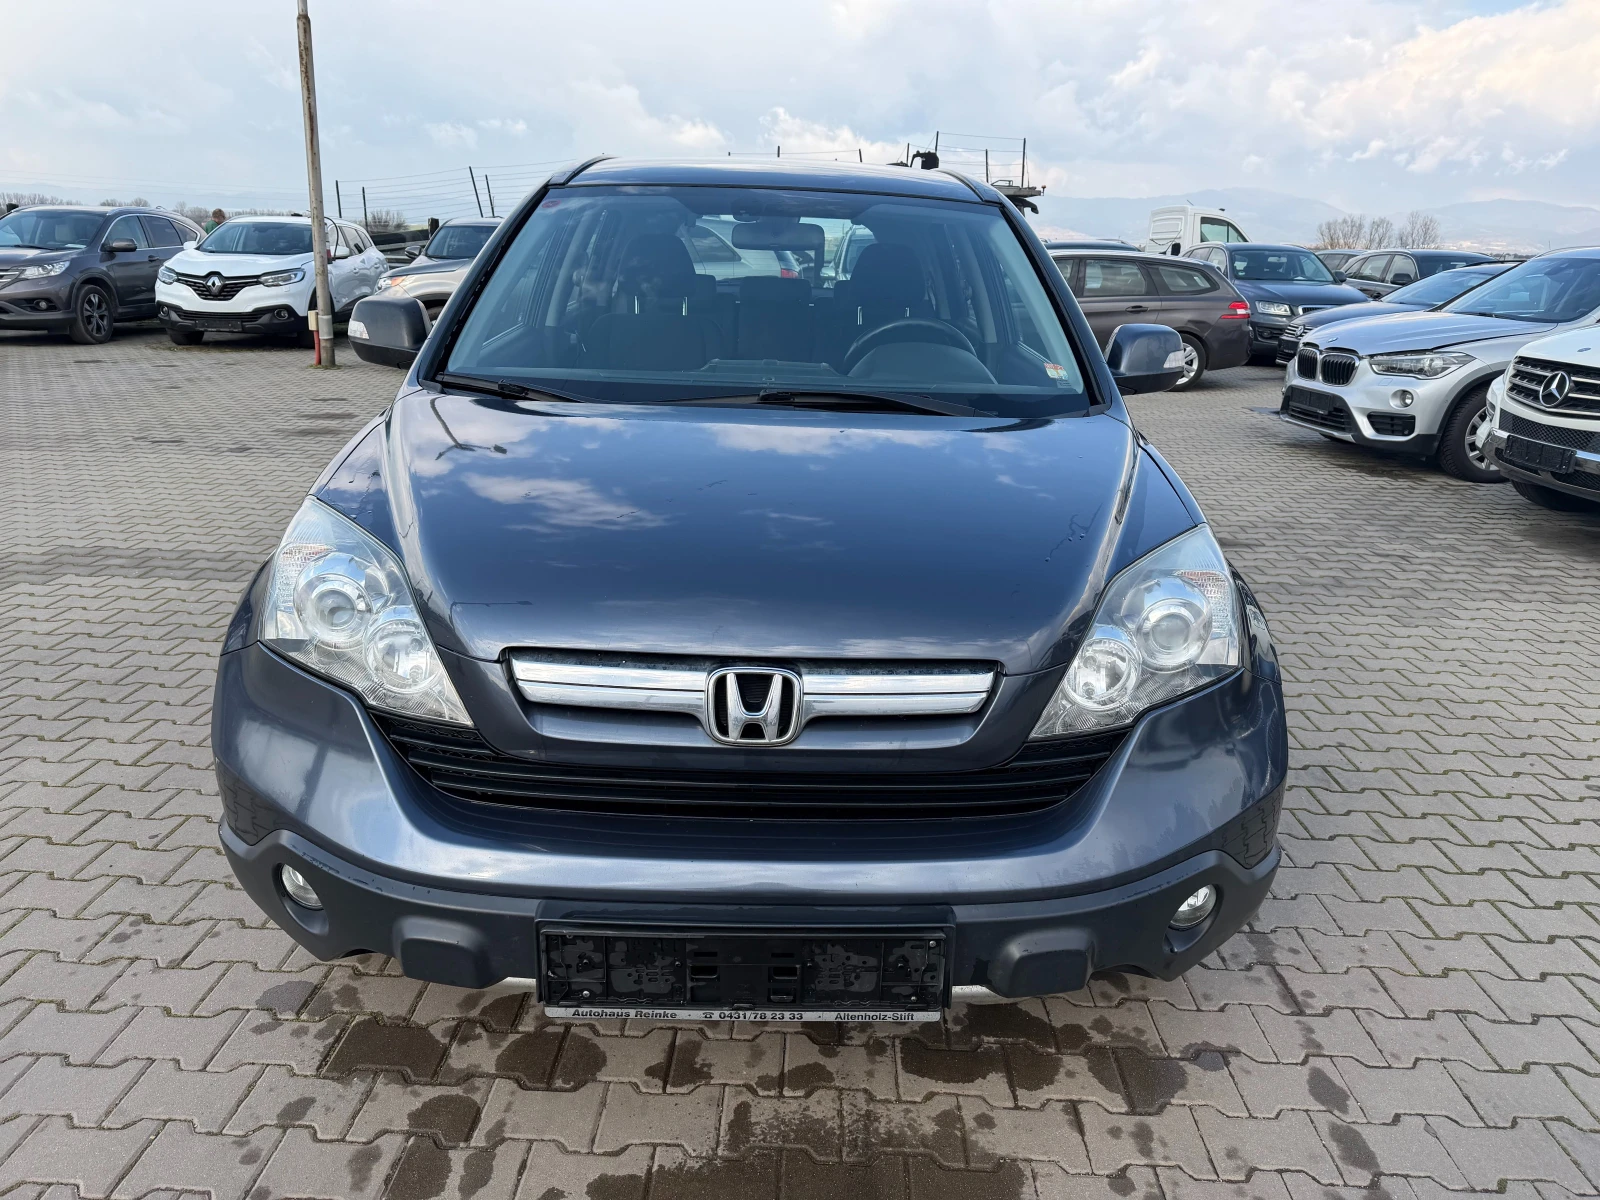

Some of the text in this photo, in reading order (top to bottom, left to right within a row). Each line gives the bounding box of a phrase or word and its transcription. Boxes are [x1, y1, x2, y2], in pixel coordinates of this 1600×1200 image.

[571, 1008, 915, 1022] Autohaus Reinke 0431/78 23 33 Altenholz-Stift
